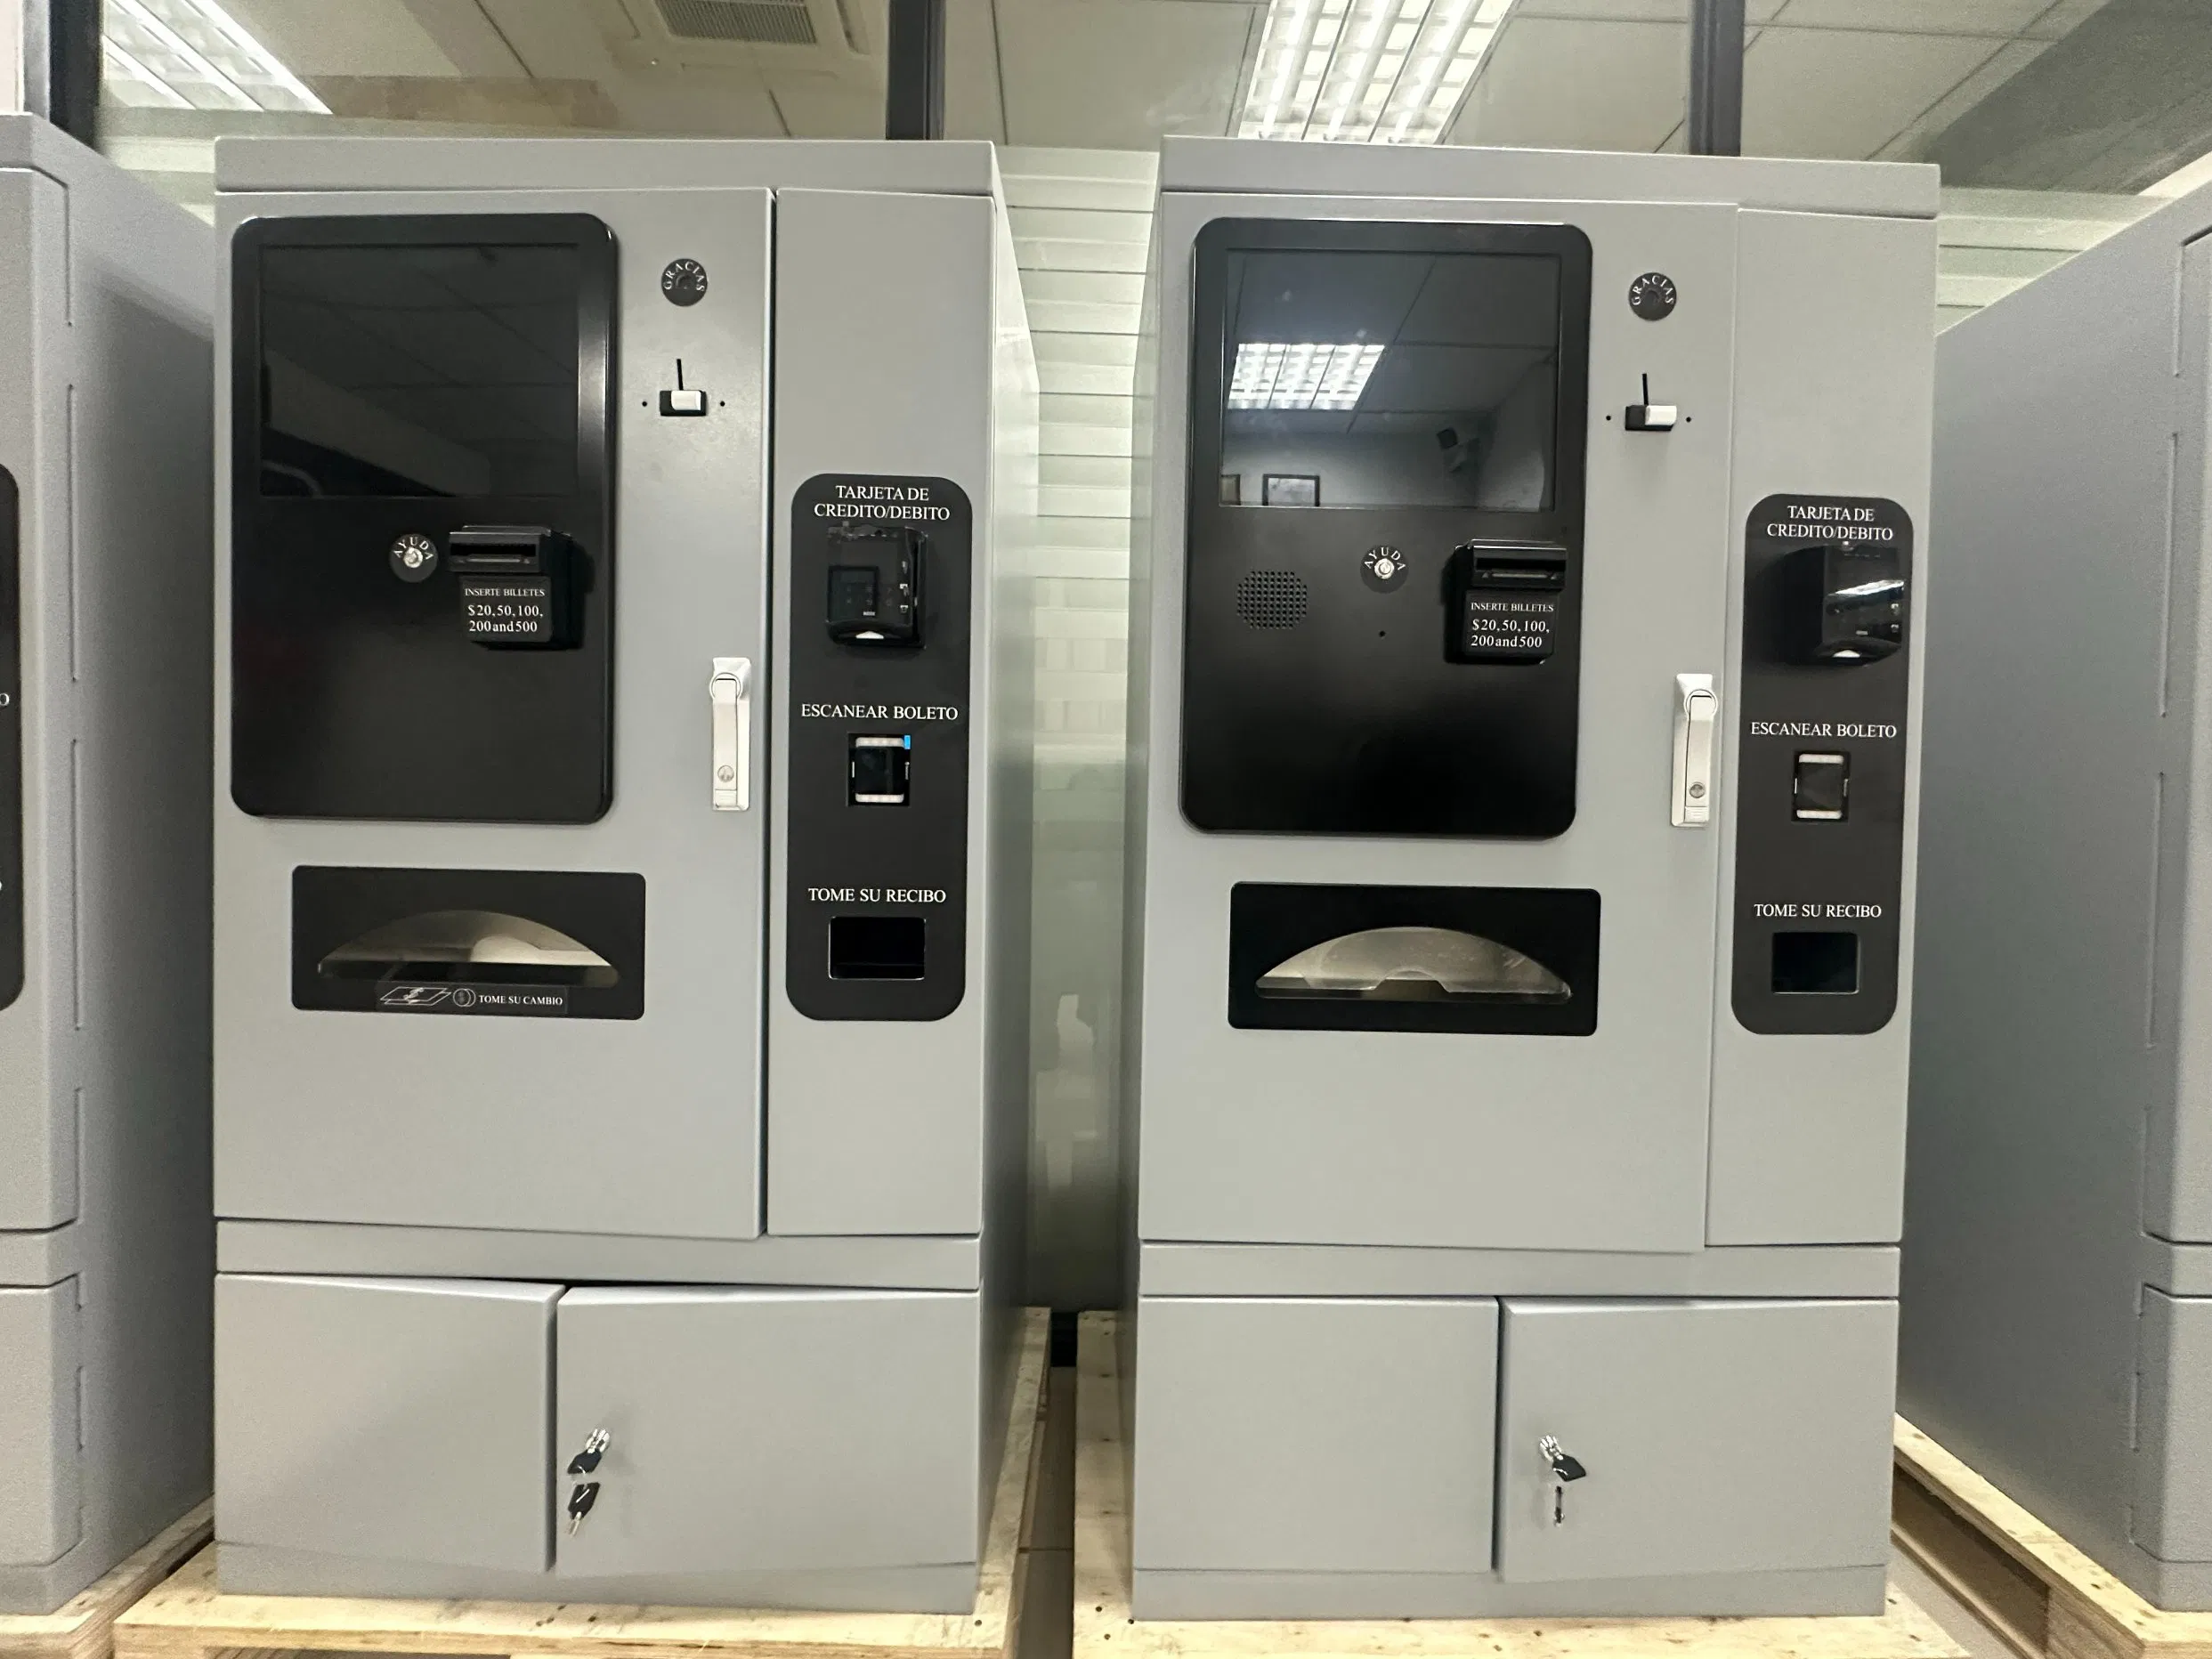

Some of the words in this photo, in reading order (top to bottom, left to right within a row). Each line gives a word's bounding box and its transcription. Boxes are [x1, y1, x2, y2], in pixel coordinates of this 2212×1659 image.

[663, 261, 704, 291] GRACIAS
[1632, 275, 1673, 305] GRACIAS
[835, 485, 904, 500] TARJETA
[907, 487, 929, 501] DE
[814, 503, 951, 521] CREDITO/DEBITO
[1787, 505, 1851, 521] TARJETA
[1853, 507, 1875, 522] DE
[1766, 523, 1893, 541] CREDITO/DEBITO
[393, 537, 433, 559] AYUDA
[1364, 547, 1406, 570] AYUDA
[465, 588, 500, 597] INSERTE
[503, 588, 546, 597] BILLETES
[1471, 602, 1508, 611] INSERTE
[1511, 603, 1554, 612] BILLETES
[801, 703, 888, 719] ESCANEAR
[894, 706, 959, 721] BOLETO
[1751, 721, 1833, 737] ESCANEAR
[1836, 724, 1897, 738] BOLETO
[807, 887, 855, 902] TOME
[859, 888, 881, 902] SU
[886, 888, 947, 903] RECIBO
[1754, 903, 1797, 918] TOME
[1801, 903, 1821, 918] SU
[1826, 904, 1882, 918] RECIBO
[479, 994, 506, 1004] TOME
[508, 995, 521, 1005] SU
[523, 996, 563, 1006] CAMBIO
